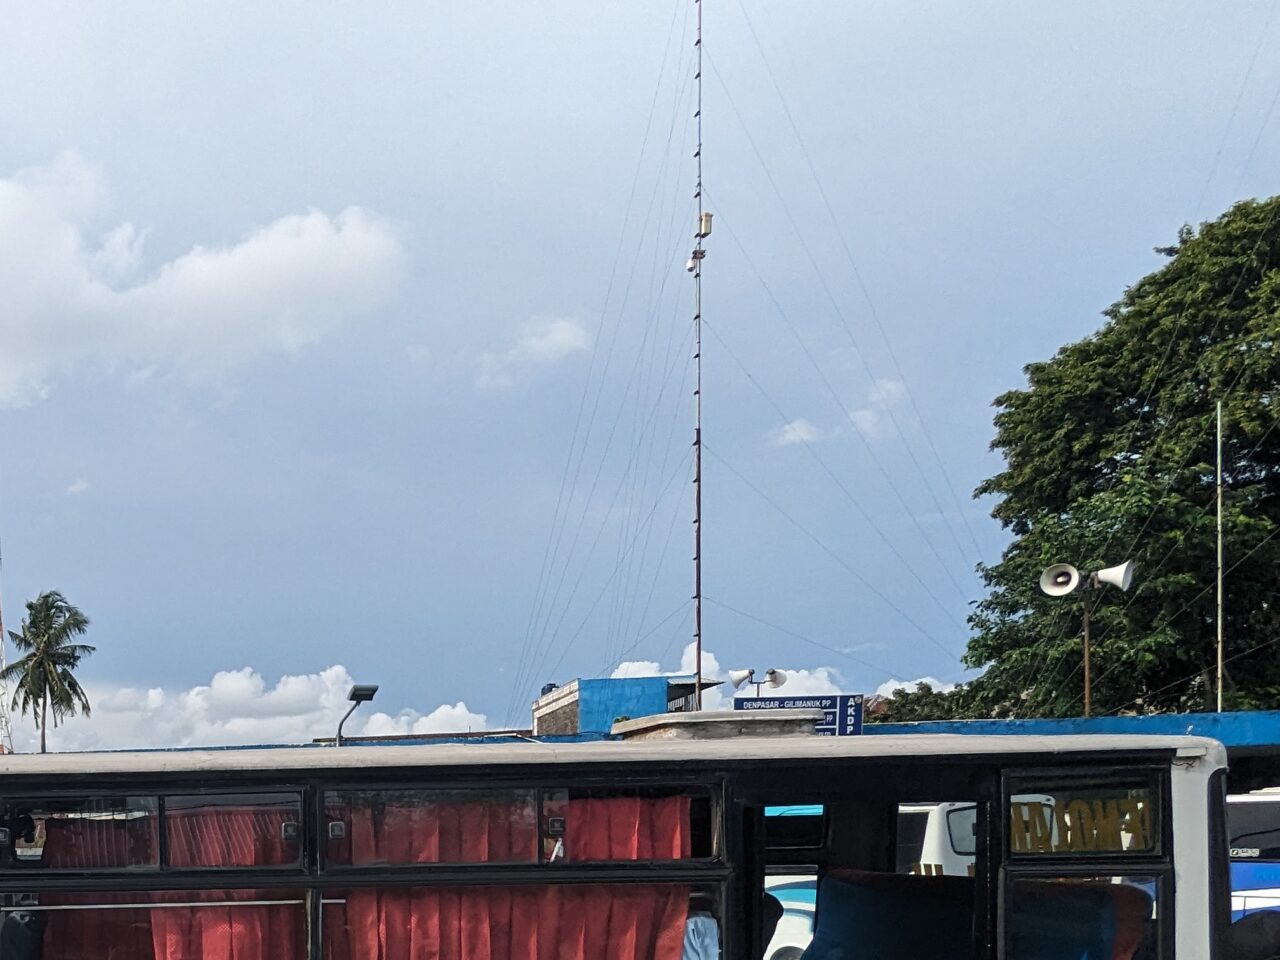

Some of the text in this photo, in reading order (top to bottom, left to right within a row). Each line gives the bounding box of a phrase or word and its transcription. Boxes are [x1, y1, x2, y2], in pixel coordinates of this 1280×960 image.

[743, 701, 780, 709] DENPASAR
[784, 700, 821, 708] GILIMANUK
[822, 699, 831, 707] PP
